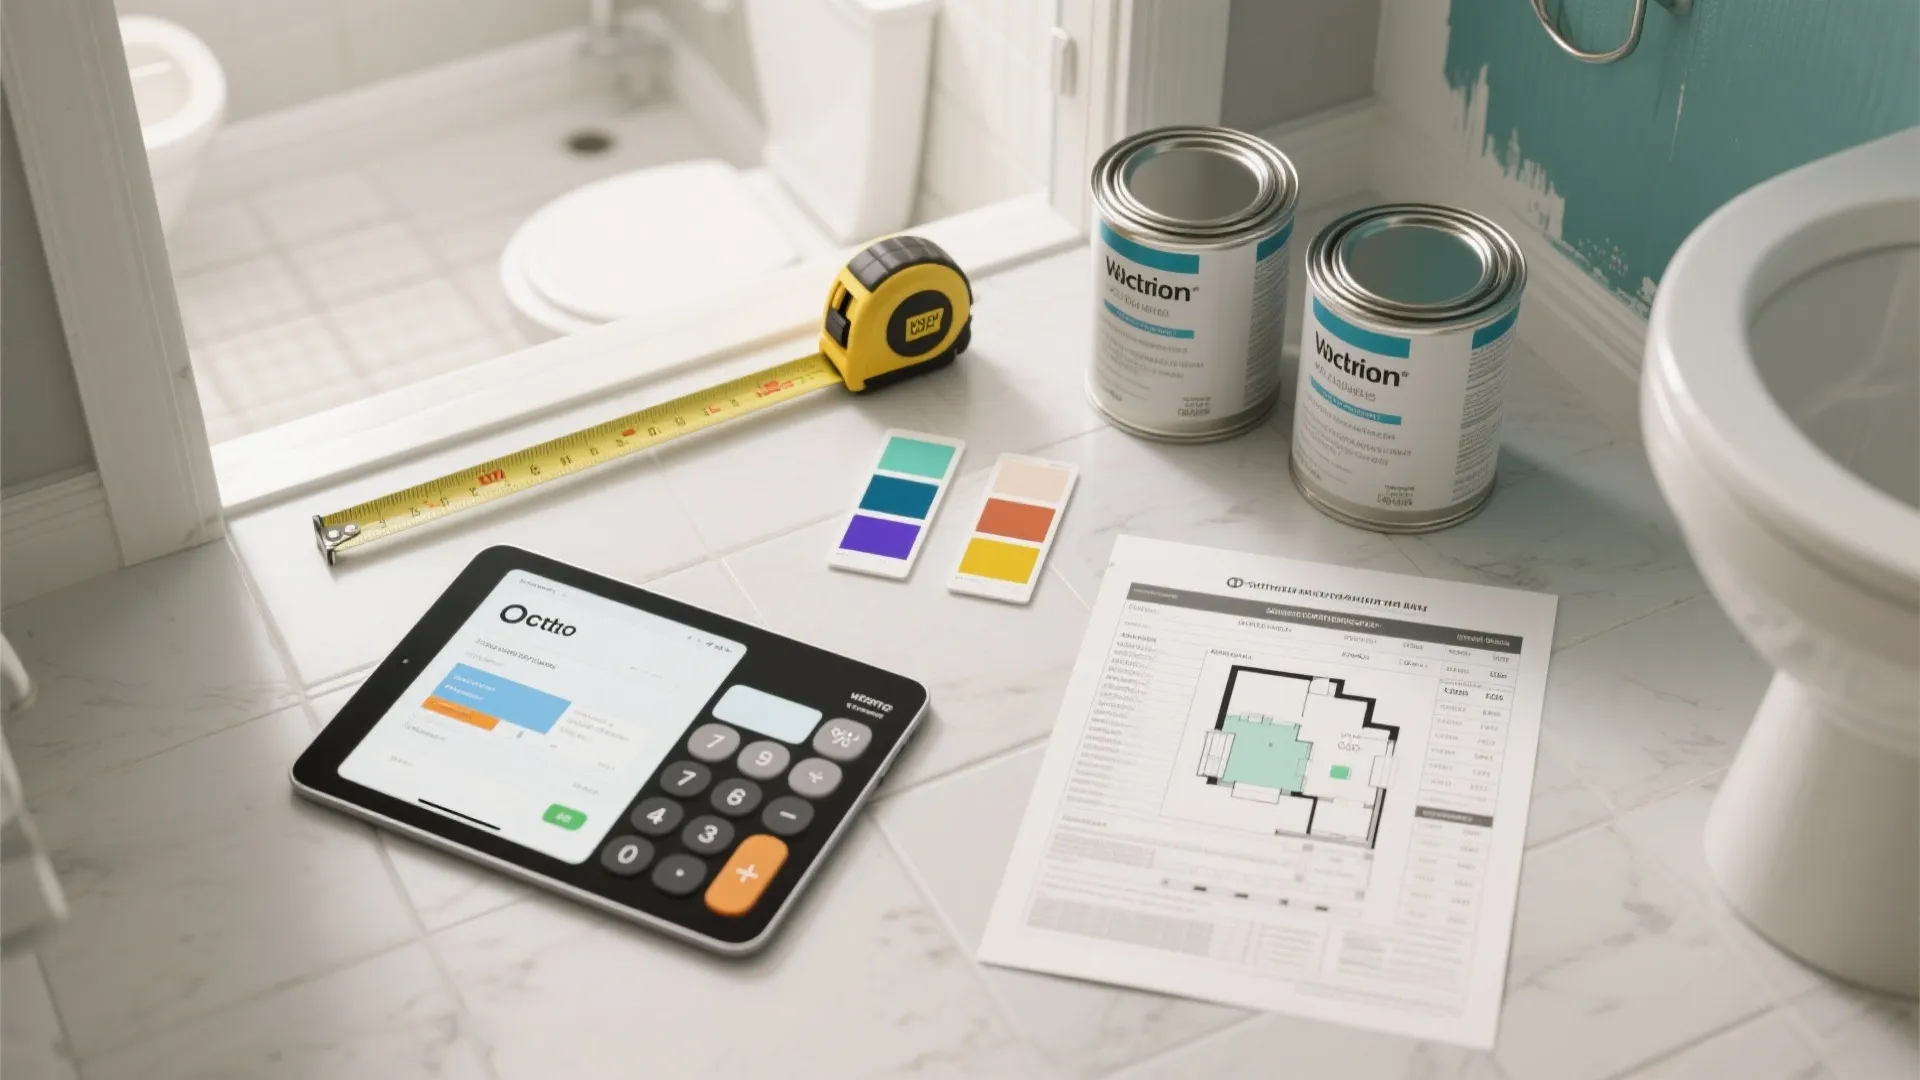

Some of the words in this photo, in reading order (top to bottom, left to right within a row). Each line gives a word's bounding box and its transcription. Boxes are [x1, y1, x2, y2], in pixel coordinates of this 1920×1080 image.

[677, 770, 697, 786] 7
[726, 788, 746, 806] 6
[646, 807, 667, 825] 4
[698, 824, 718, 844] 3
[617, 844, 639, 864] 0
